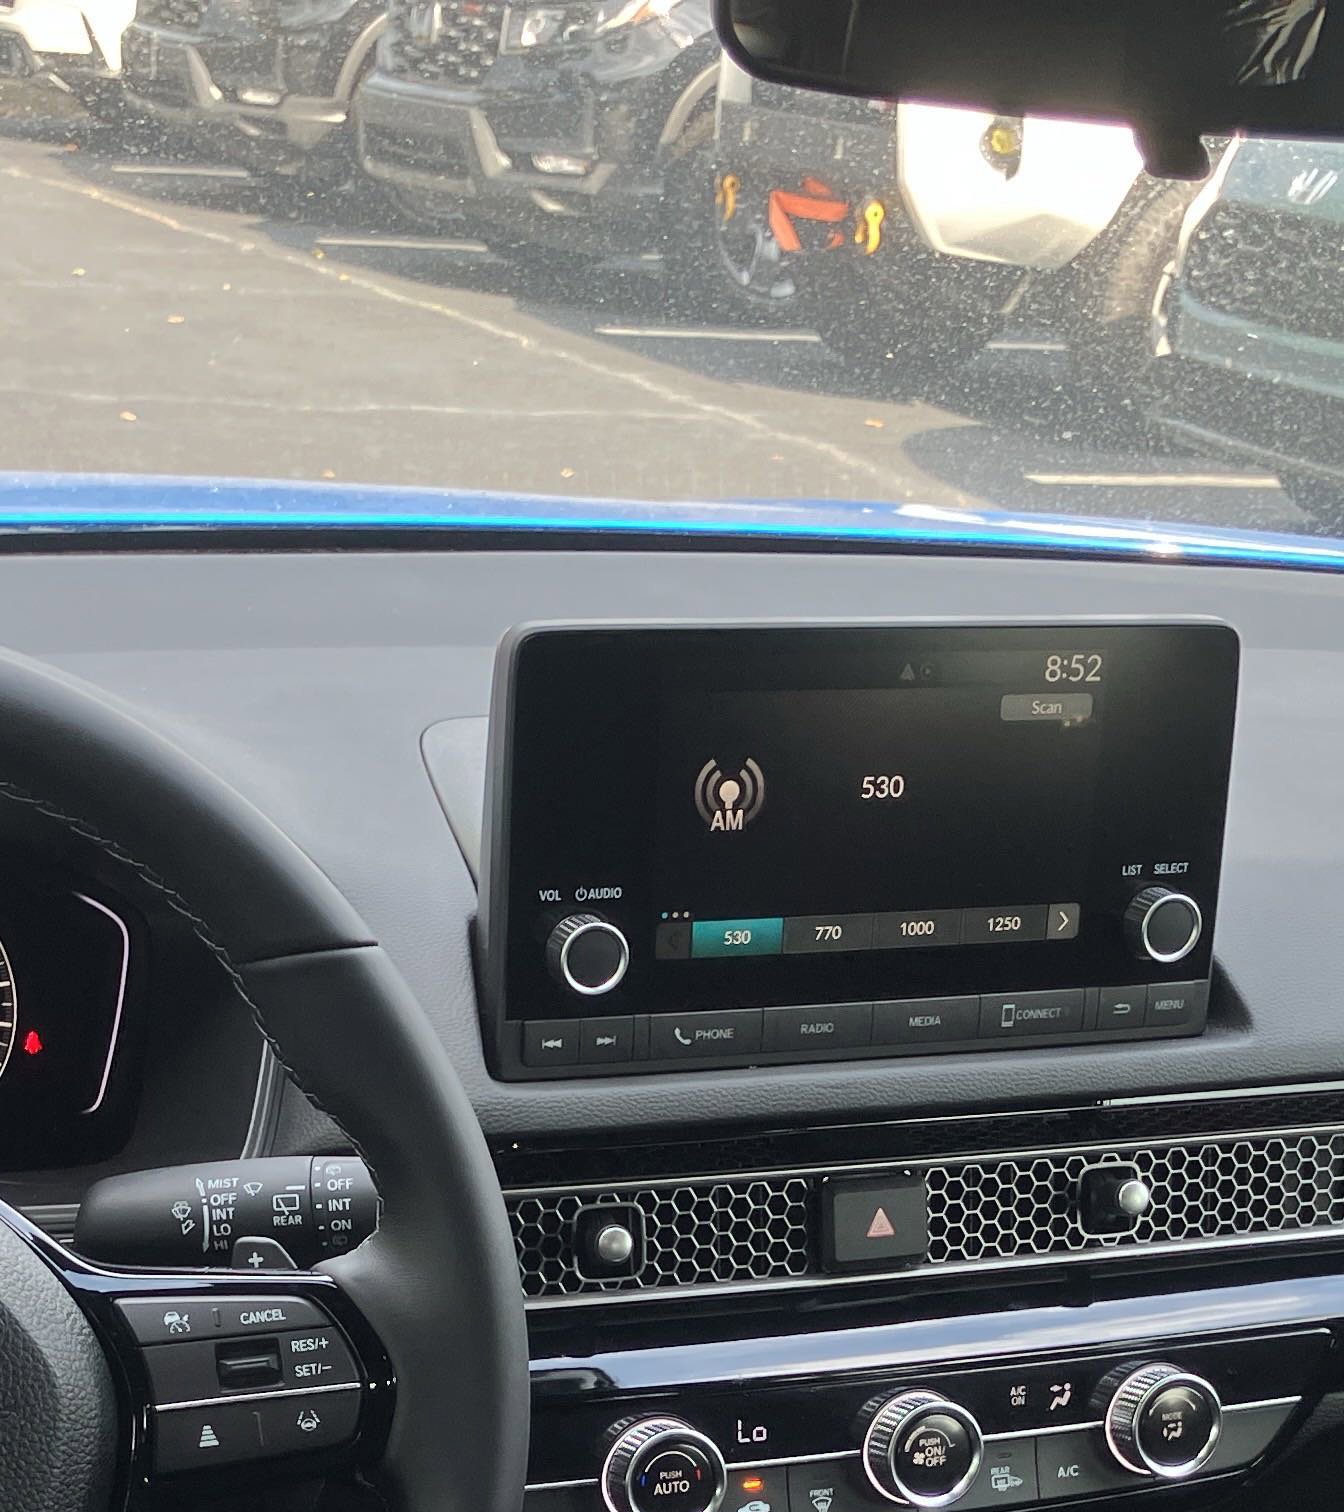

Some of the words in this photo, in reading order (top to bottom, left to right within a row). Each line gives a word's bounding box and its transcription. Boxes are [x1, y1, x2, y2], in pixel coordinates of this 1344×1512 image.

[1044, 654, 1103, 684] 8:52
[1031, 700, 1063, 715] Scan
[860, 775, 905, 800] 530
[710, 808, 744, 833] AM
[1121, 864, 1142, 876] LIST
[1153, 861, 1189, 875] SELECT
[538, 889, 562, 902] VOL
[587, 887, 623, 900] AUDIO
[899, 921, 935, 936] 1000
[987, 916, 1021, 932] 1250
[723, 930, 752, 946] 530
[815, 925, 842, 941] 770
[1155, 999, 1184, 1010] MENU
[1016, 1007, 1062, 1020] CONNECT
[908, 1015, 941, 1027] MEDIA
[695, 1028, 735, 1041] PHONE
[800, 1023, 835, 1035] RADIO
[207, 1177, 239, 1189] MIST
[326, 1178, 354, 1191] OFF
[210, 1192, 237, 1206] OFF
[328, 1199, 351, 1212] INT
[211, 1207, 235, 1221] INT
[272, 1215, 302, 1227] REAR
[330, 1219, 352, 1232] ON
[213, 1223, 232, 1237] LO
[214, 1240, 228, 1250] HI
[240, 1309, 287, 1325] CANCEL
[1010, 1386, 1026, 1397] A/C
[1011, 1396, 1025, 1406] ON
[737, 1419, 768, 1443] Lo
[919, 1437, 940, 1447] PUSH
[925, 1446, 946, 1457] ON/
[925, 1455, 947, 1467] OFF
[660, 1470, 682, 1480] PUSH
[1057, 1464, 1080, 1478] A/C
[654, 1480, 690, 1495] AUTO
[809, 1487, 834, 1498] FRONT
